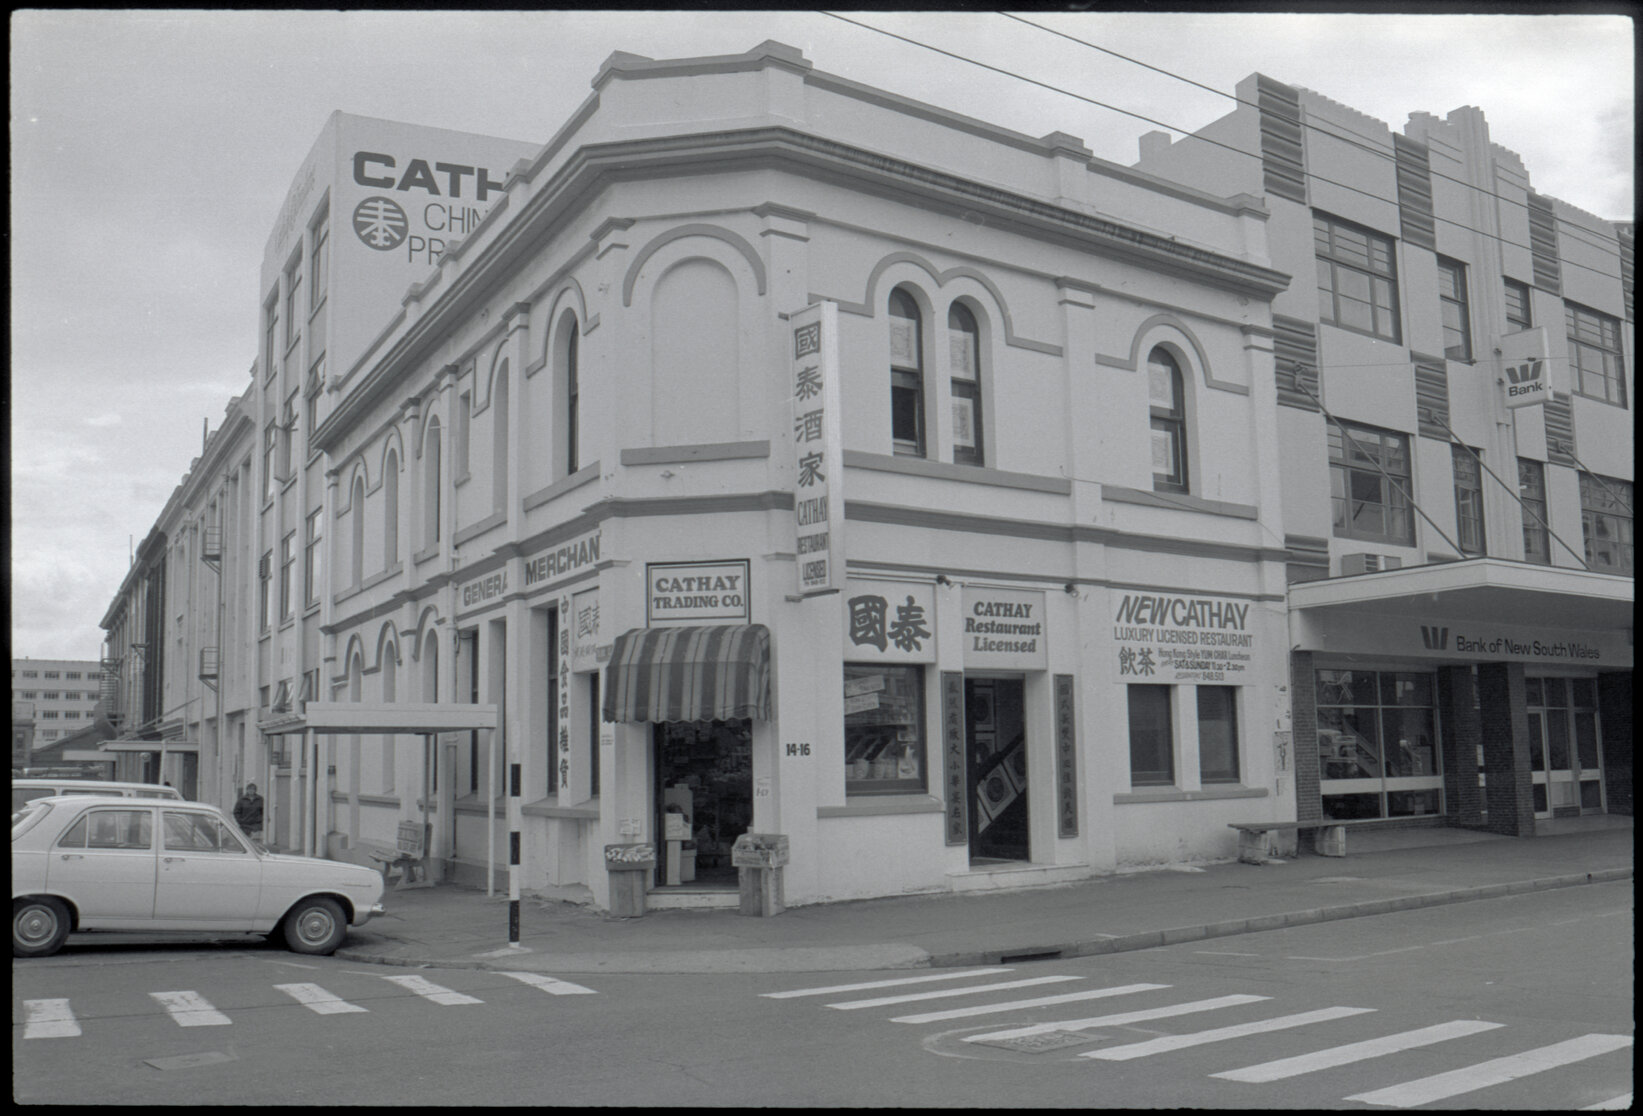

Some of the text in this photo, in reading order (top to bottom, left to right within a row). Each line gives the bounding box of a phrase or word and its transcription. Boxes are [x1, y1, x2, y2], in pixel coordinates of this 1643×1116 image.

[1509, 382, 1543, 396] Bank
[793, 320, 826, 488] 國泰酒家
[797, 496, 828, 526] CATHAY
[655, 575, 741, 593] CATHAY
[653, 595, 744, 609] TRADING CO.
[973, 601, 1033, 619] CATHAY
[1116, 595, 1249, 631] NEW CATHAY
[847, 595, 932, 653] 國泰
[965, 617, 1041, 636] Restaurant
[972, 637, 1036, 653] Licensed
[1114, 627, 1253, 648] LUXURY LICENSED RESTAURANT
[1457, 635, 1600, 659] Bank of New South Wales
[1119, 646, 1156, 676] 飲茶
[786, 743, 811, 756] 14-16
